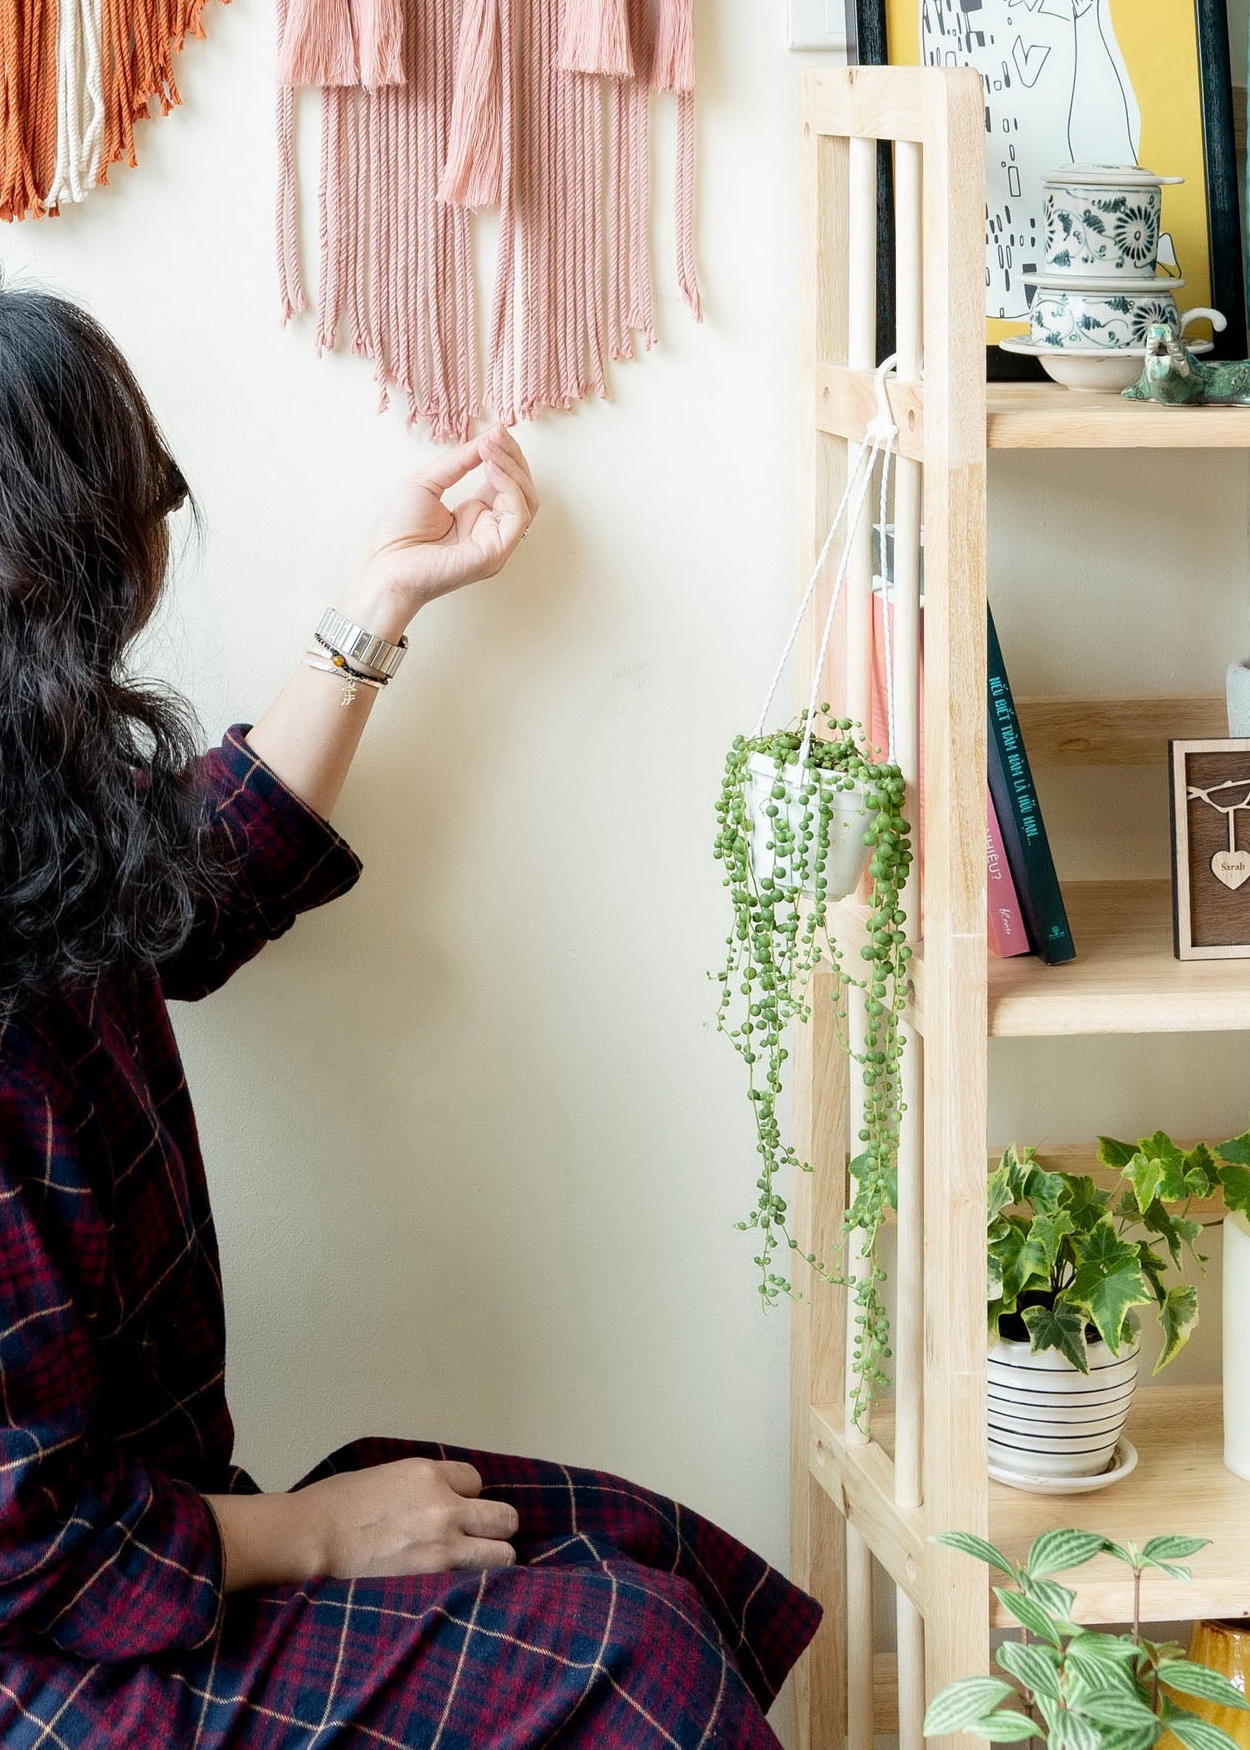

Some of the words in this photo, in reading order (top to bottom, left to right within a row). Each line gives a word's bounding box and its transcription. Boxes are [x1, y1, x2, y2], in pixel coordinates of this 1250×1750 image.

[989, 676, 1009, 697] NẾU
[994, 697, 1015, 721] BIẾT
[1013, 778, 1031, 793] LÀ
[1221, 862, 1246, 872] Sarah
